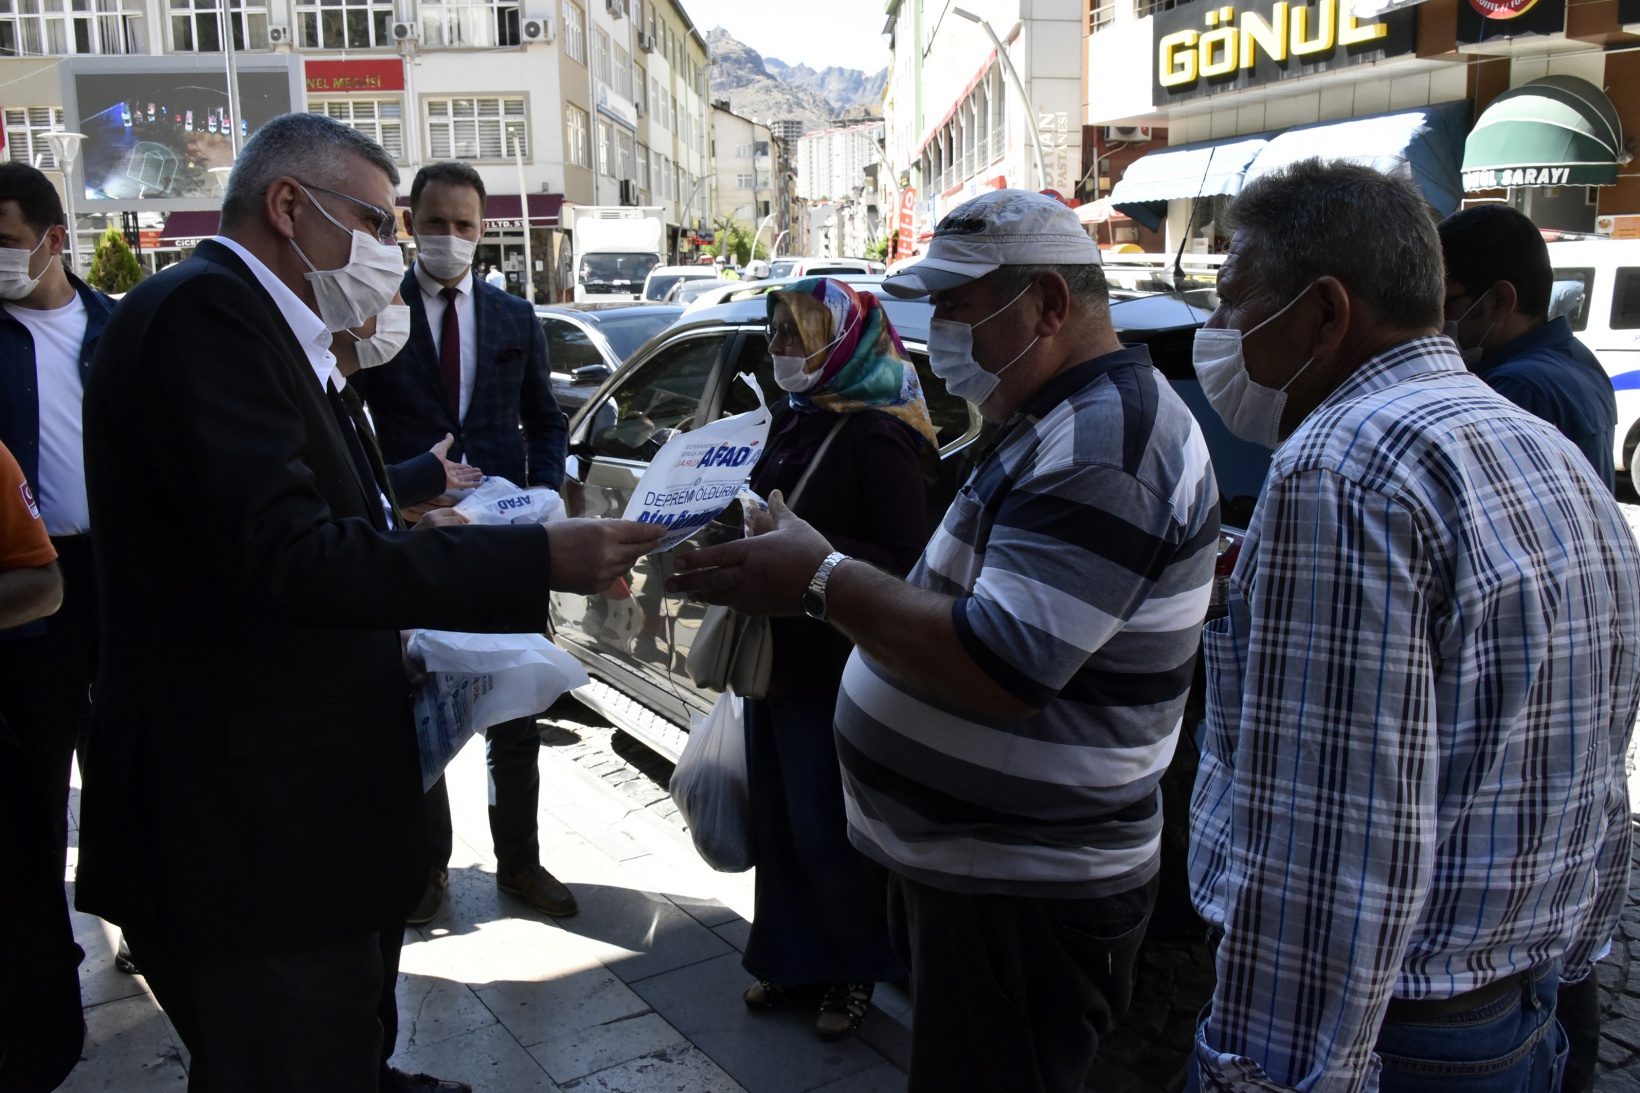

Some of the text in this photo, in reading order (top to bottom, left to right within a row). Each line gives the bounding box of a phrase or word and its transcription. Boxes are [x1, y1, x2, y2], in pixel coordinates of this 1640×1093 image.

[1501, 168, 1570, 186] SARAYI
[696, 446, 750, 468] AFAD
[497, 494, 531, 510] AFAD
